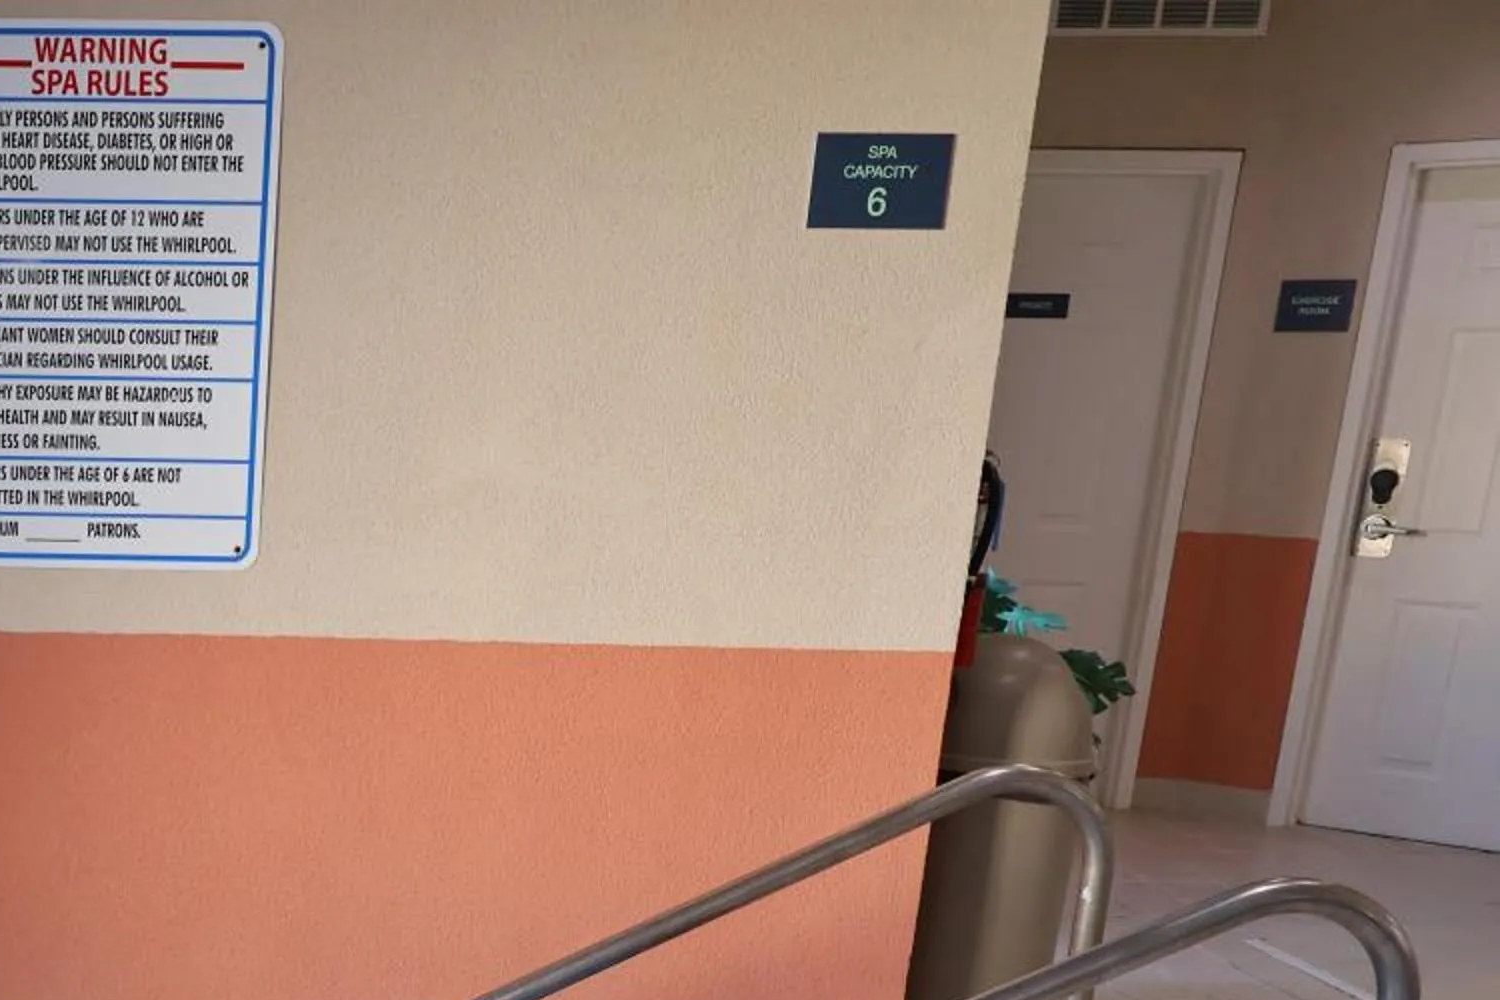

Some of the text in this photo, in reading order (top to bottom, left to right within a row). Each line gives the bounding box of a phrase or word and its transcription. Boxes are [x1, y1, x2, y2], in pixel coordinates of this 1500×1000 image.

[35, 38, 168, 65] WARNING
[31, 69, 169, 97] SPA RULES
[15, 110, 69, 128] PERSONS
[72, 111, 98, 128] AND
[101, 111, 155, 129] PERSONS
[158, 111, 224, 130] SUFFERING
[2, 133, 40, 149] HEART
[43, 133, 94, 150] DISEASE,
[97, 133, 156, 150] DIABETES,
[160, 133, 177, 151] OR
[180, 134, 212, 151] HIGH
[215, 134, 234, 151] OR
[868, 146, 897, 159] SPA
[39, 155, 97, 171] PRESSURE
[100, 155, 150, 172] SHOULD
[153, 155, 178, 172] NOT
[181, 155, 219, 172] ENTER
[222, 156, 244, 173] THE
[843, 165, 918, 179] CAPACITY
[866, 187, 887, 217] 6
[14, 209, 55, 226] UNDER
[59, 210, 80, 226] THE
[83, 210, 108, 226] AGE
[111, 210, 127, 227] OF
[131, 211, 145, 227] 12
[149, 211, 179, 227] WHO
[181, 211, 205, 227] ARE
[55, 236, 80, 252] MAY
[83, 236, 108, 252] NOT
[111, 236, 133, 252] USE
[136, 236, 158, 253] THE
[161, 237, 236, 254] WHIRLPOOL.
[18, 269, 59, 286] UNDER
[62, 270, 84, 286] THE
[87, 270, 152, 287] INFLUENCE
[155, 270, 171, 287] OF
[174, 271, 229, 287] ALCOHOL
[231, 271, 249, 288] OR
[6, 295, 31, 311] MAY
[34, 295, 58, 311] NOT
[61, 295, 83, 312] USE
[87, 296, 109, 312] THE
[111, 296, 186, 313] WHIRLPOOL.
[27, 328, 74, 344] WOMEN
[77, 328, 125, 345] SHOULD
[129, 329, 182, 345] CONSULT
[184, 329, 218, 346] THEIR
[26, 353, 95, 369] REGARDING
[98, 354, 168, 370] WHIRLPOOL
[171, 355, 213, 371] USAGE.
[15, 385, 74, 401] EXPOSURE
[77, 386, 101, 402] MAY
[105, 386, 120, 402] BE
[123, 386, 194, 403] HAZARDOUS
[196, 387, 213, 403] TO
[42, 410, 67, 426] AND
[70, 410, 95, 426] MAY
[99, 411, 139, 427] RESULT
[141, 411, 155, 427] IN
[158, 411, 207, 428] NAUSEA,
[23, 434, 40, 450] OR
[43, 435, 100, 450] FAINTING.
[10, 466, 50, 482] UNDER
[54, 466, 75, 482] THE
[77, 467, 100, 482] AGE
[103, 467, 119, 483] OF
[122, 467, 130, 483] 6
[133, 467, 155, 483] ARE
[157, 467, 182, 483] NOT
[27, 490, 40, 506] IN
[43, 490, 64, 506] THE
[67, 490, 140, 507] WHIRLPOOL.
[87, 523, 141, 539] PATRONS.
